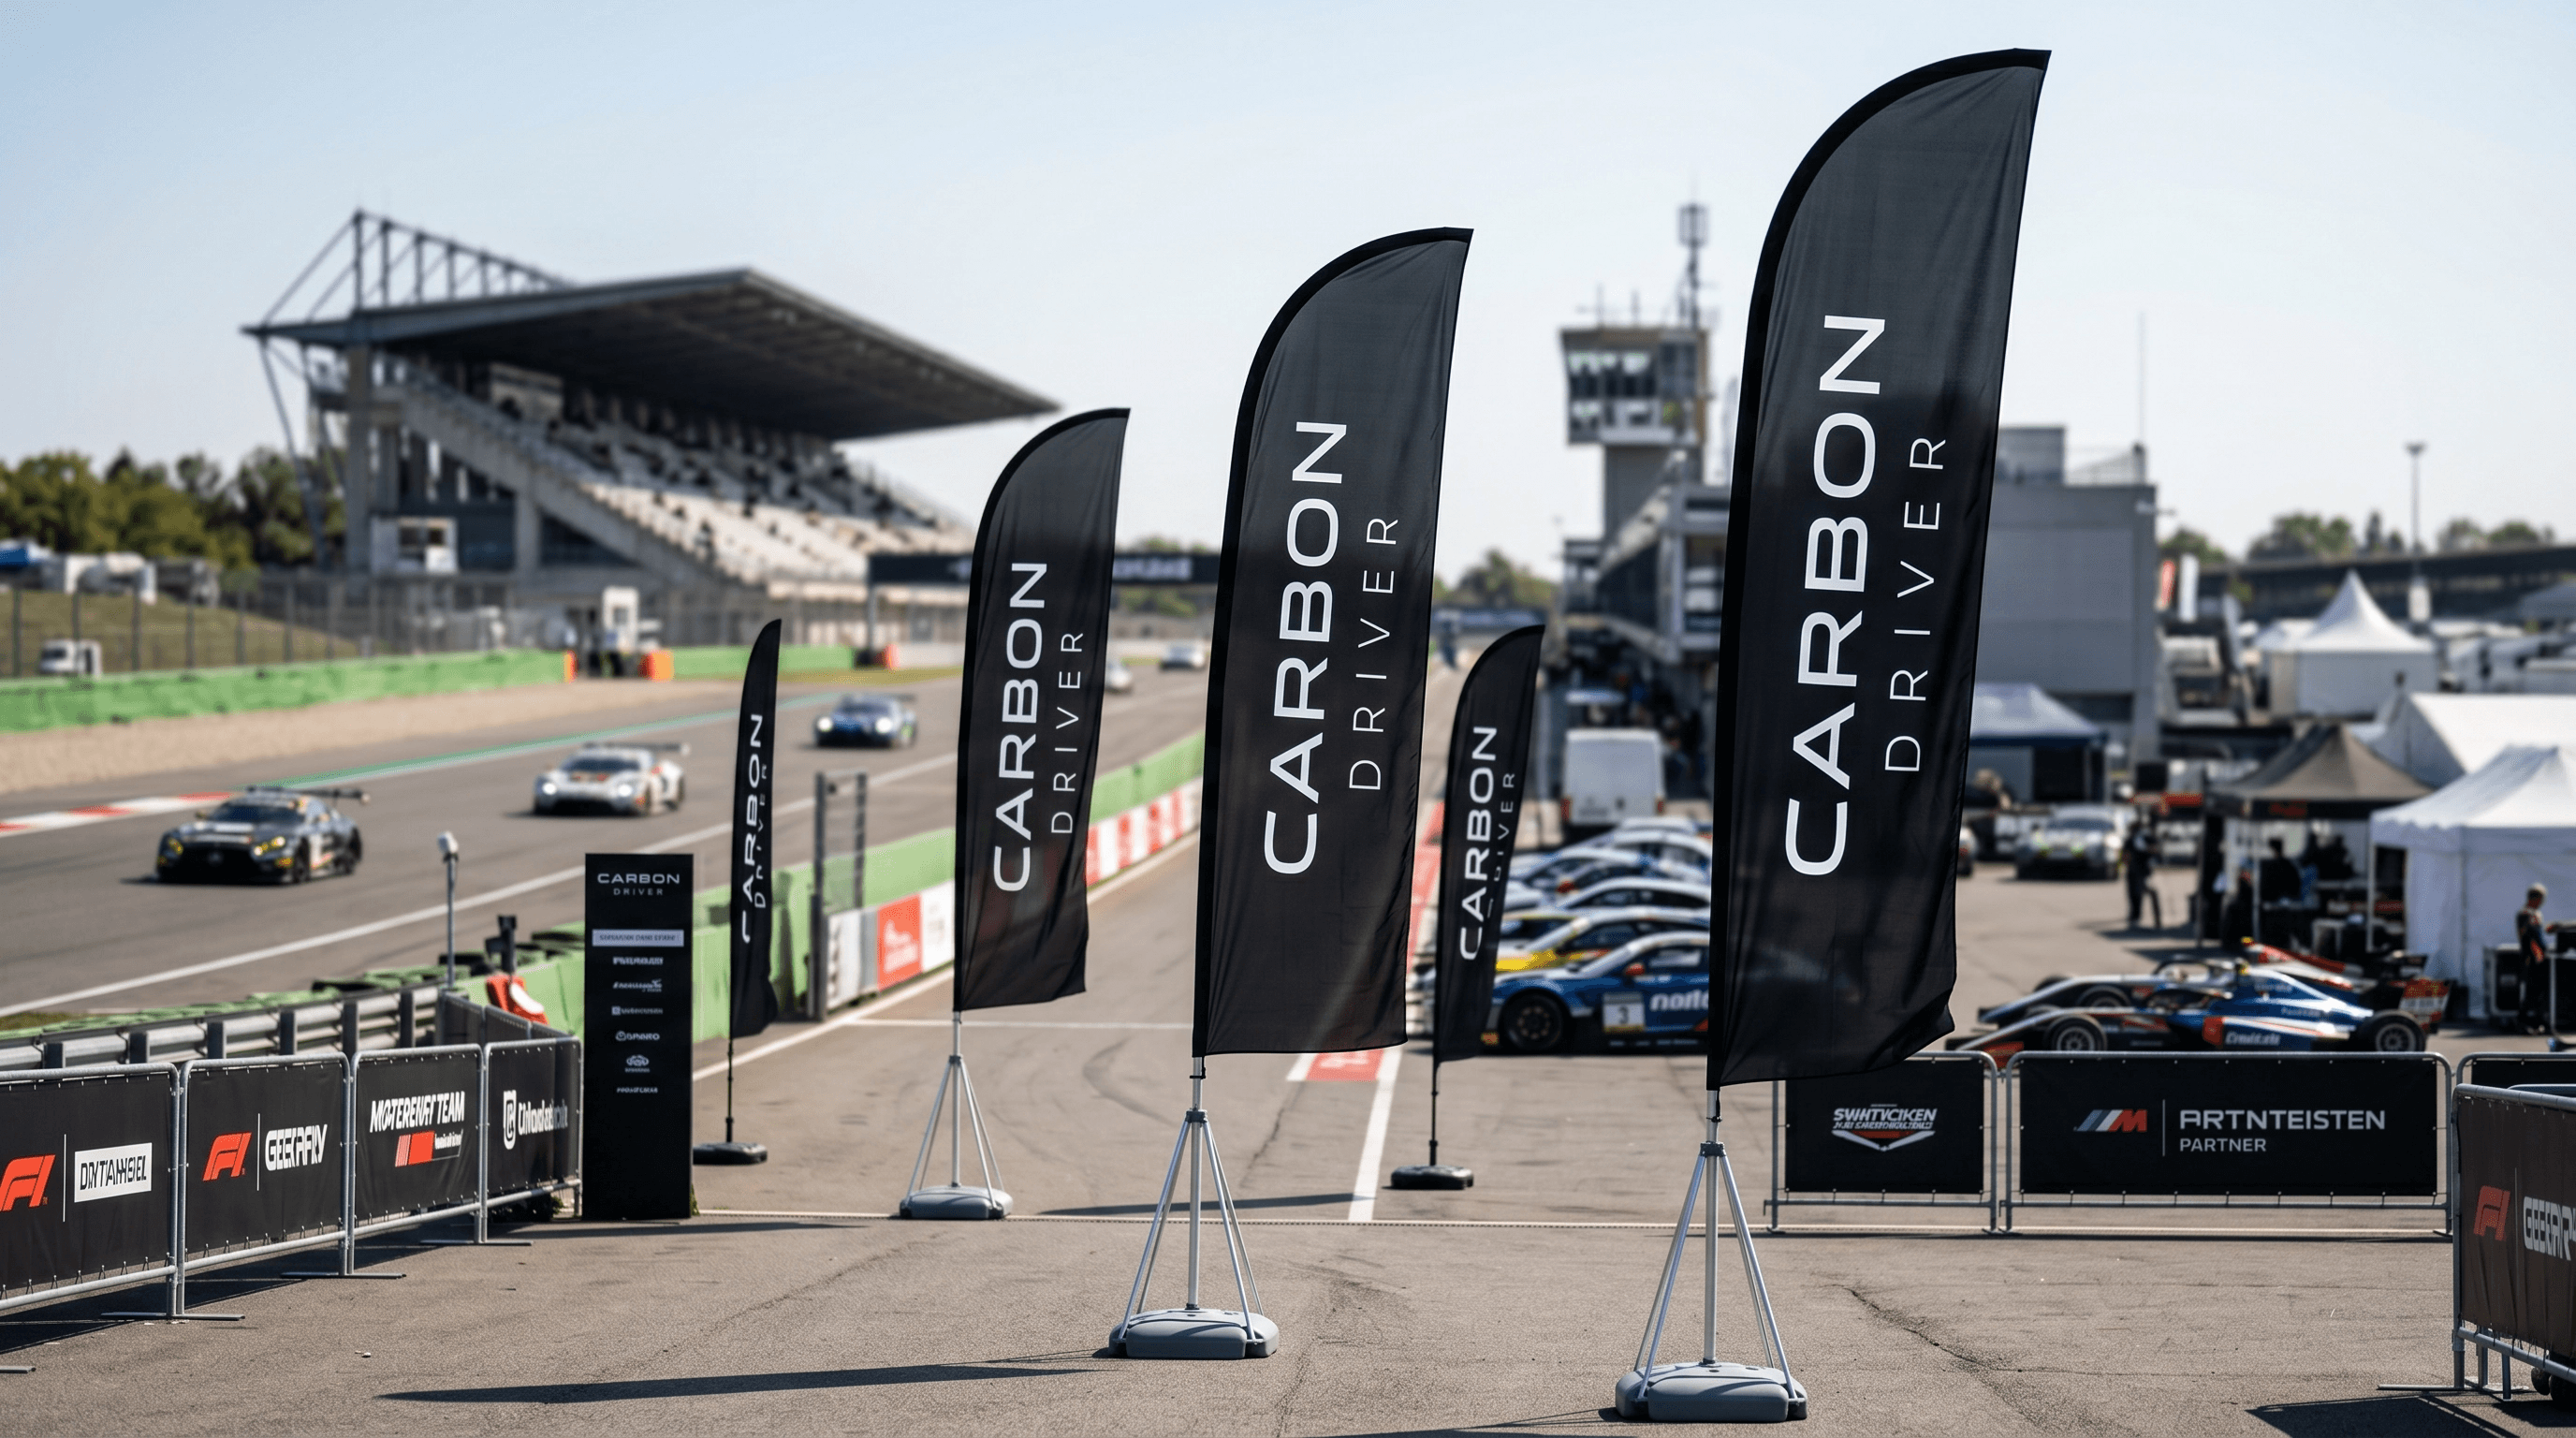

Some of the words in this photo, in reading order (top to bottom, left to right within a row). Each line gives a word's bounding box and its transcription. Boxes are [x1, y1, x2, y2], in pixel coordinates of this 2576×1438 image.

[1264, 421, 1347, 874] CARBON
[1349, 518, 1398, 790] DRIVER
[1785, 315, 1886, 876] CARBON
[1884, 437, 1946, 771] DRIVER
[993, 563, 1047, 892] CARBON
[1050, 632, 1084, 834] DRIVER
[1460, 726, 1498, 961] CARBON
[597, 873, 680, 884] CARBON
[437, 1091, 465, 1124] TEAM
[2180, 1137, 2266, 1152] PARTNER
